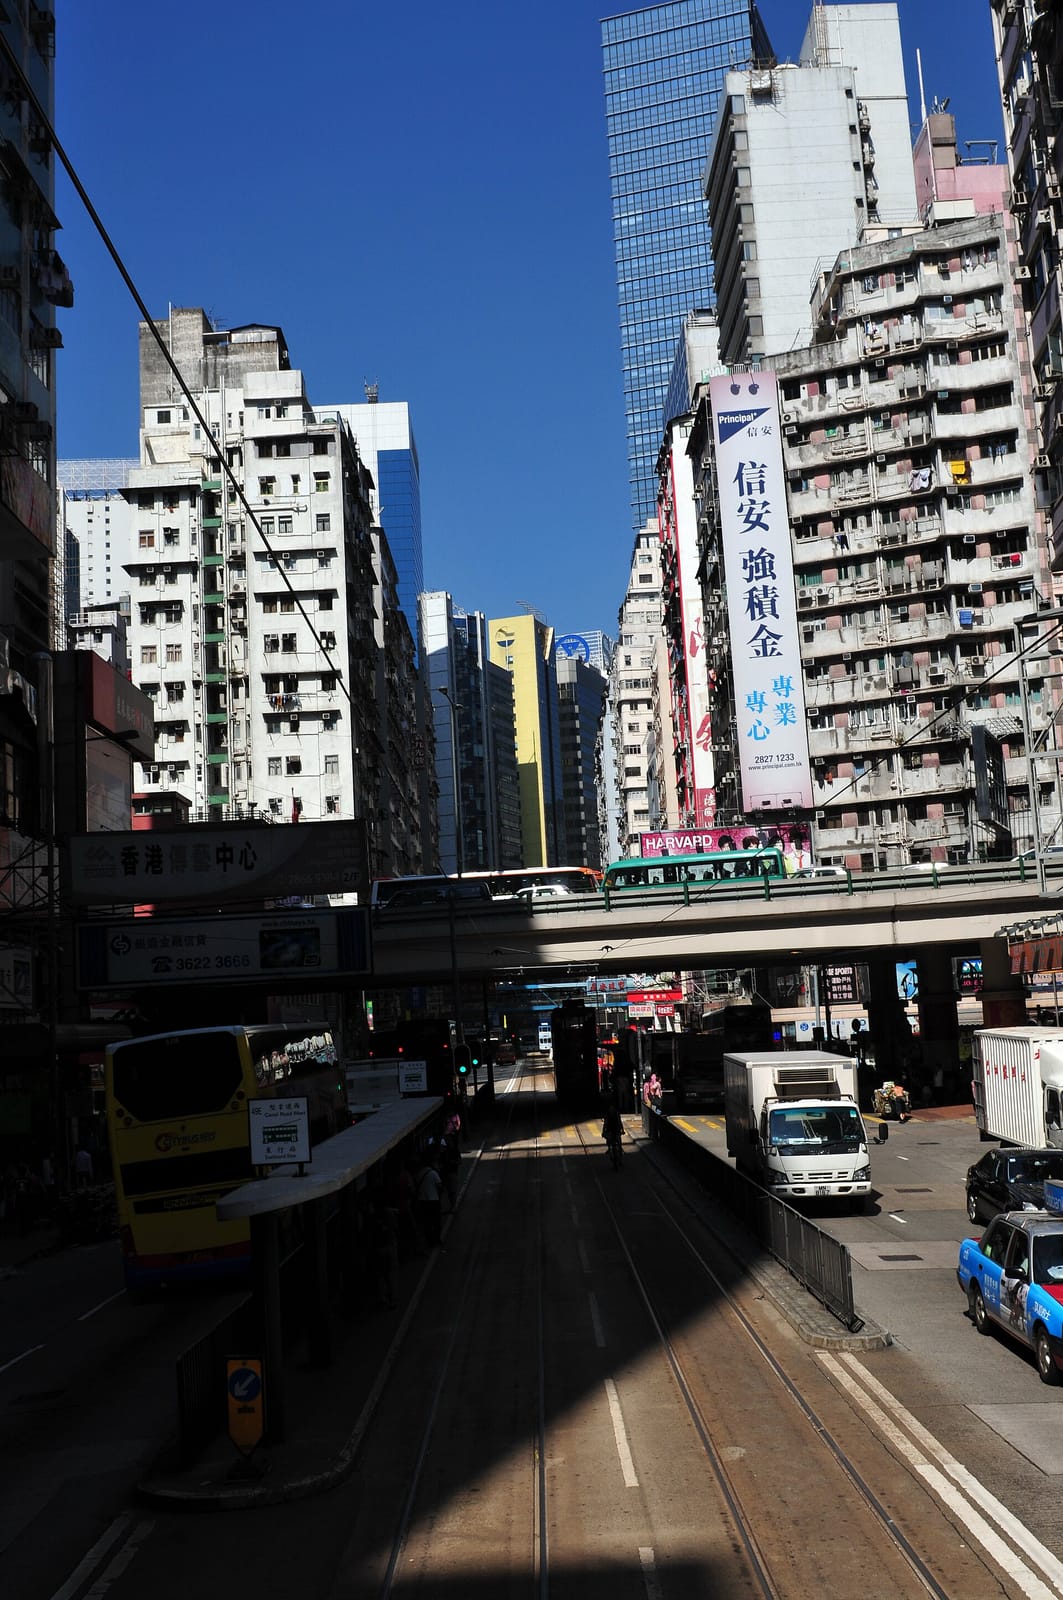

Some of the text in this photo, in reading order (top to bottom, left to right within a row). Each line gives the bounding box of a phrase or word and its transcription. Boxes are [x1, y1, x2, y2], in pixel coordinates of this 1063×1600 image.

[719, 412, 754, 424] Principal
[747, 425, 772, 438] 信安
[771, 674, 798, 727] 專業
[745, 690, 771, 741] 專心
[754, 753, 795, 764] 2827 1233
[646, 834, 713, 851] HARVARD
[175, 954, 250, 971] 3622 3666
